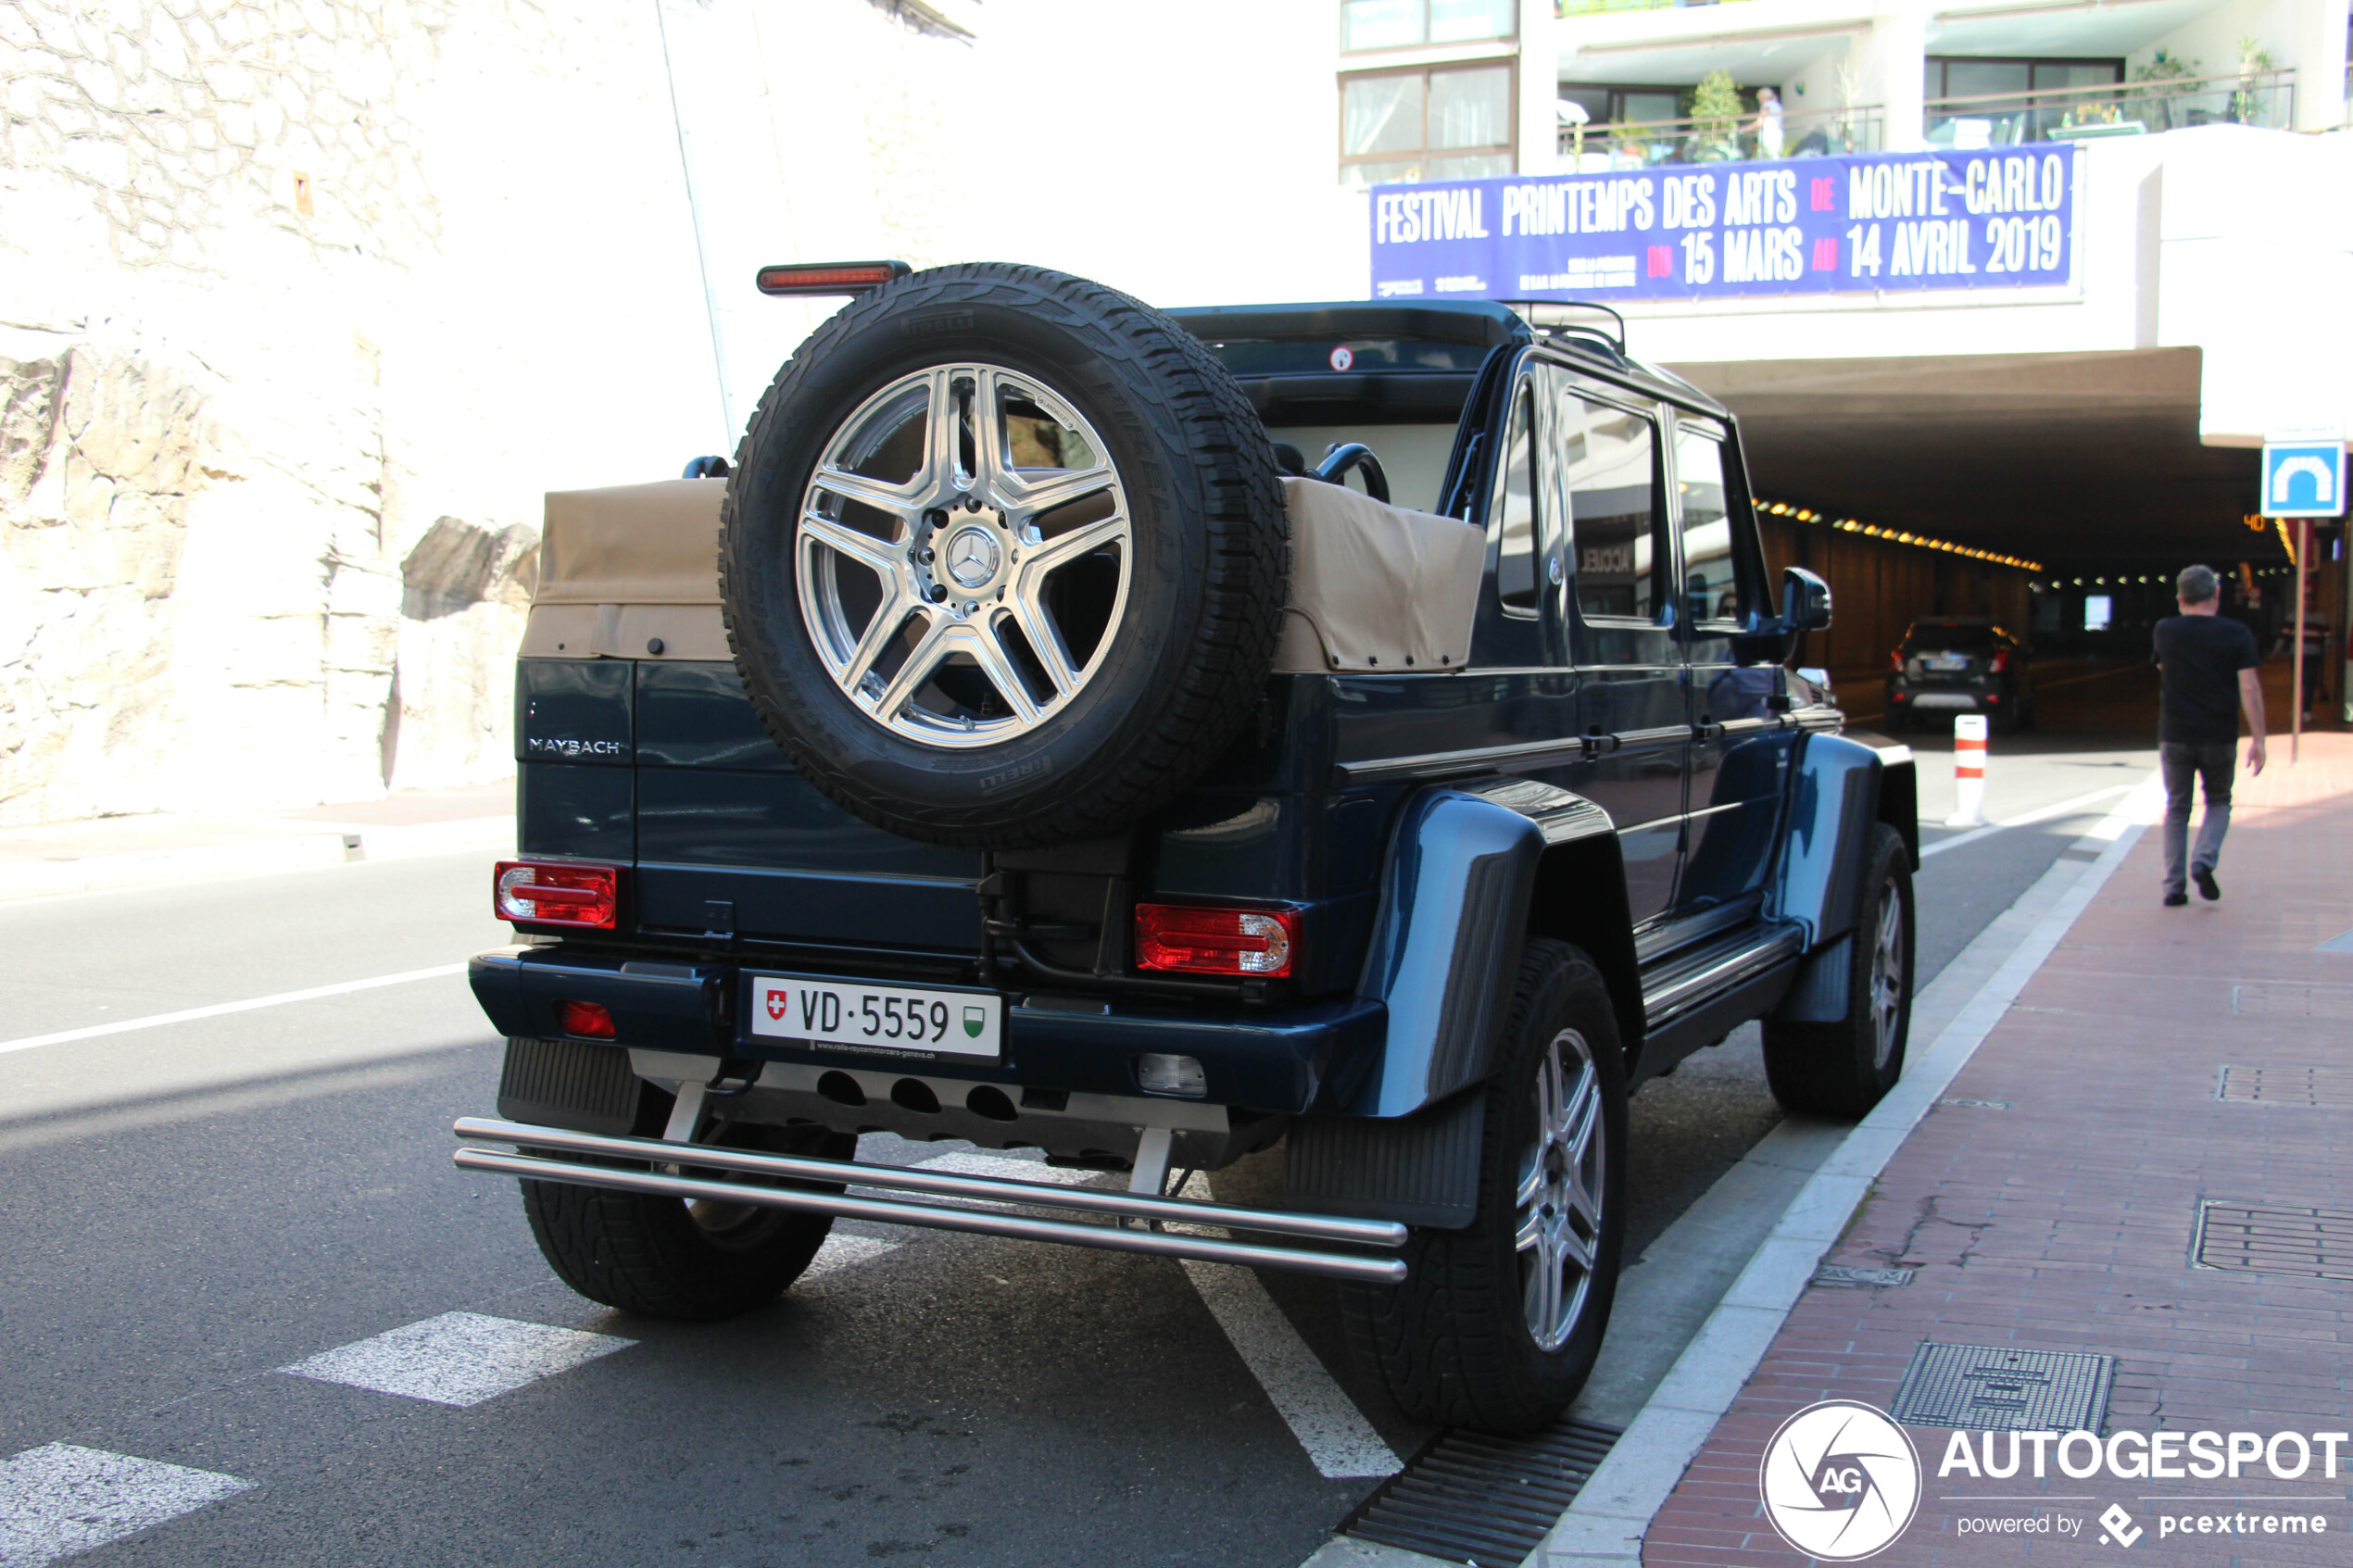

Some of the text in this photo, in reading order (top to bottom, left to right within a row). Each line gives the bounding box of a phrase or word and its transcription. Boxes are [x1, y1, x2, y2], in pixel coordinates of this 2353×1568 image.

[1378, 154, 2063, 245] FESTIVAL PRINTEMPS DES ARTS DE MONTE-CARLO
[1647, 215, 2061, 284] DU 15 MARS AU 14 AVRIL 2019
[529, 738, 620, 754] MAYBACH
